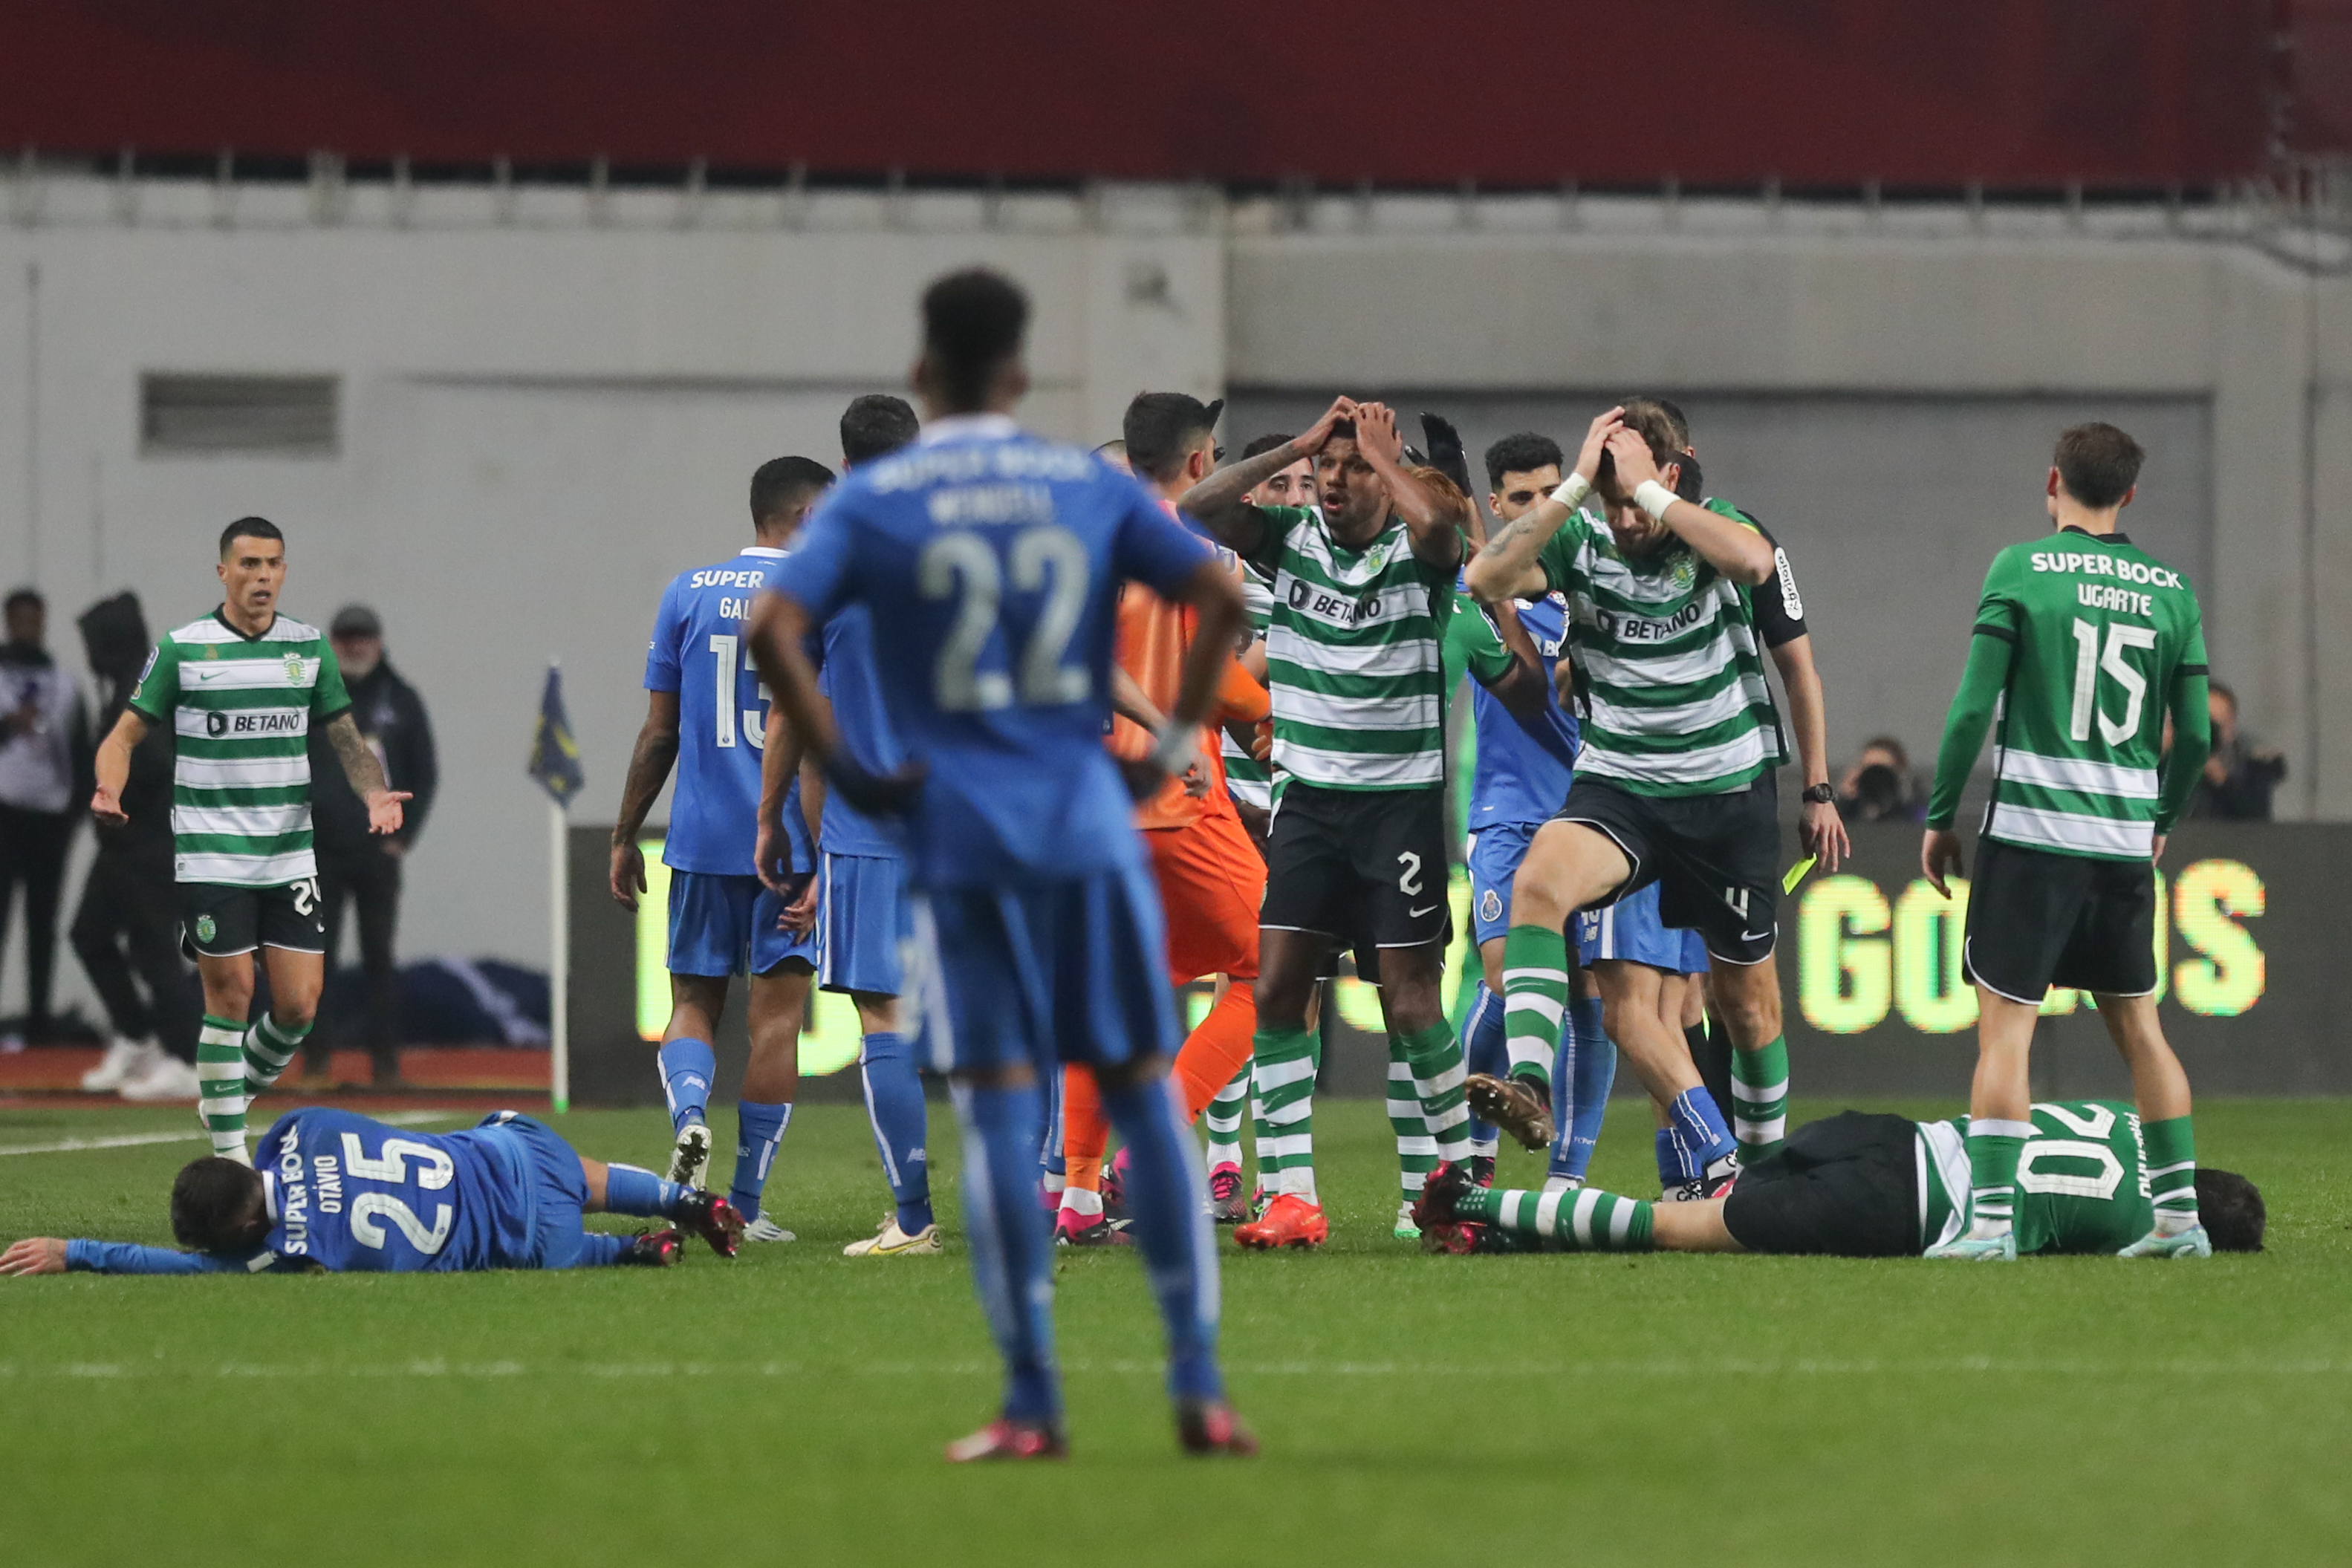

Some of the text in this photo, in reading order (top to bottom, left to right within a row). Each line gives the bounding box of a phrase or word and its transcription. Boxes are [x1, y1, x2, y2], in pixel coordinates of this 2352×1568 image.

[690, 570, 764, 588] SUPER
[2031, 553, 2184, 590] SUPER BOCK
[920, 525, 1091, 711] 22
[1313, 595, 1381, 623] BETANO
[1624, 603, 1700, 640] BETANO
[2077, 583, 2153, 617] UGARTE
[2071, 617, 2157, 747] 15
[234, 714, 299, 732] BETANO
[1397, 850, 1423, 896] 2
[1799, 858, 2266, 1034] GOS
[2016, 1103, 2125, 1200] 20
[312, 1154, 342, 1214] OTÁVIO
[341, 1132, 455, 1255] 25
[285, 1185, 308, 1255] SUPER
